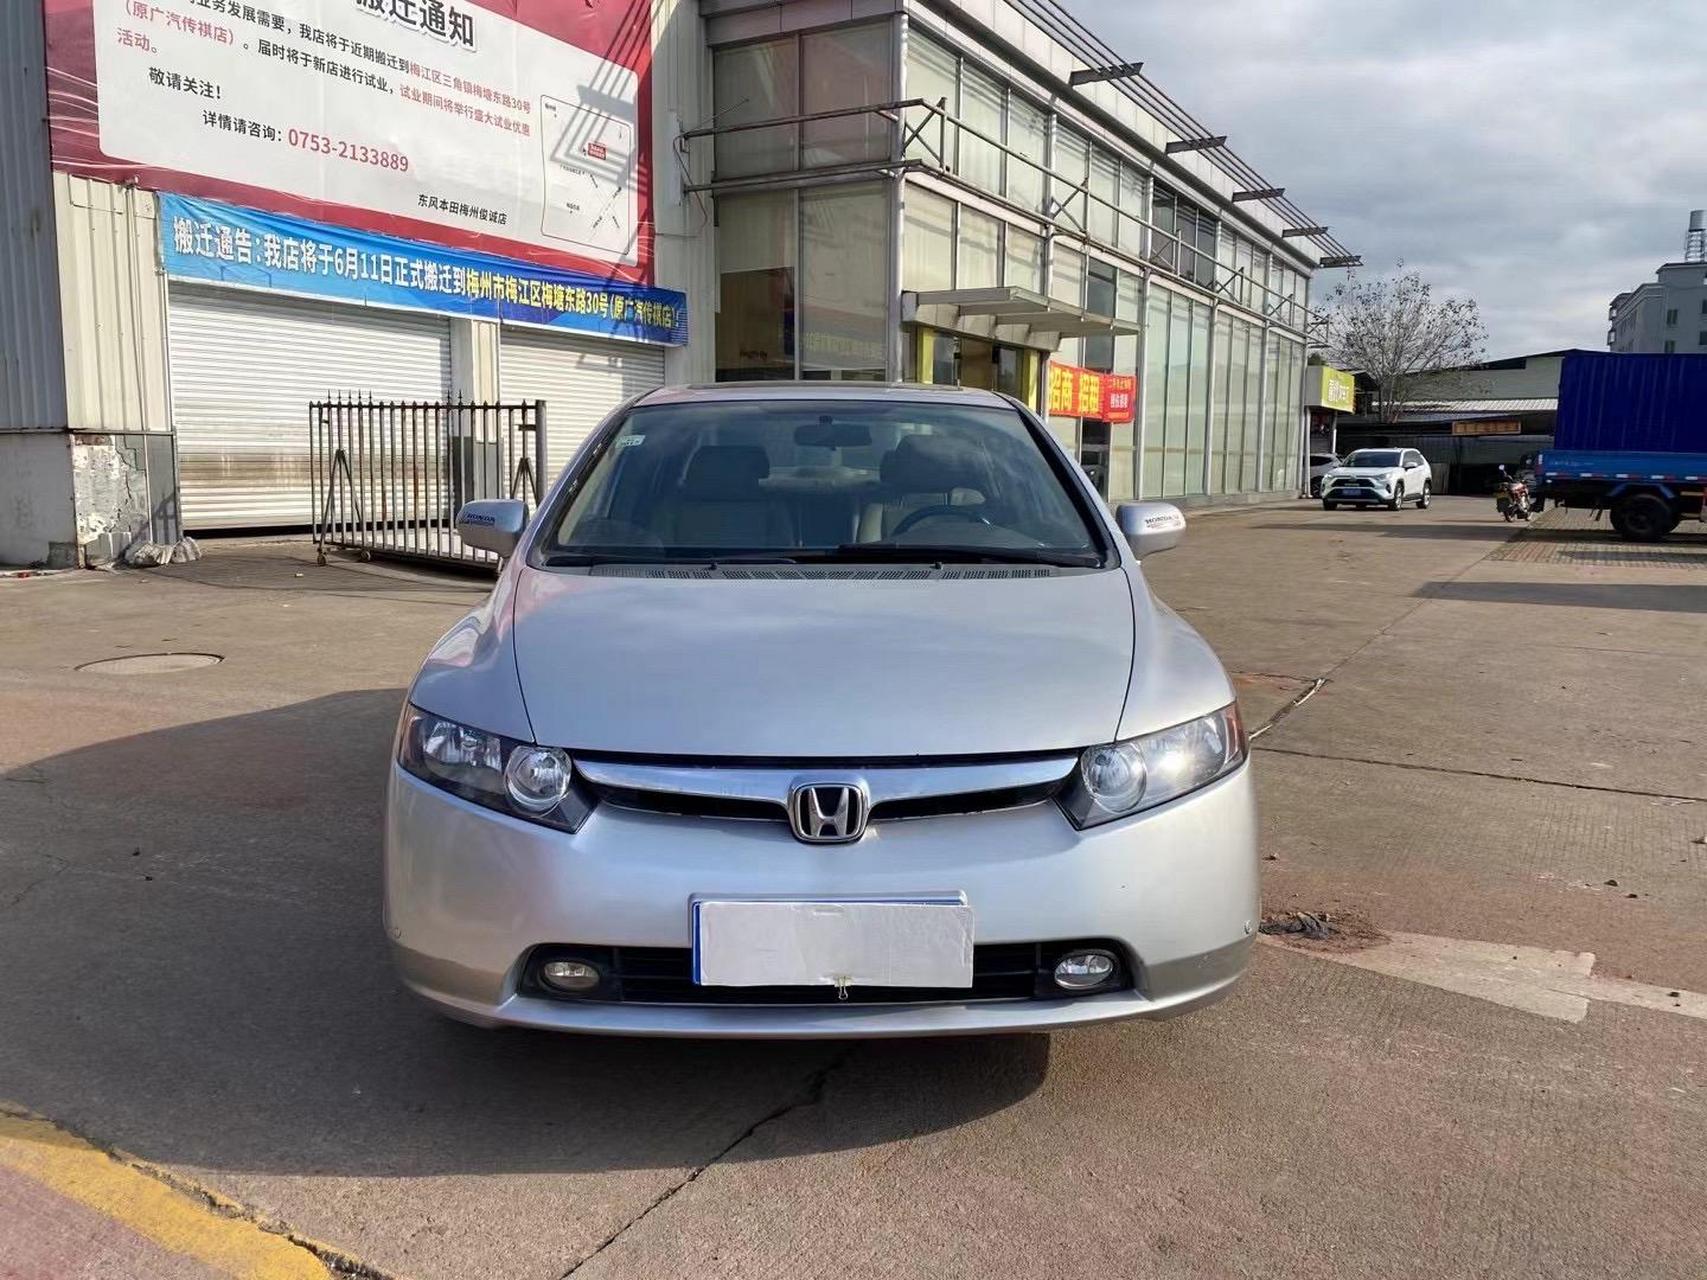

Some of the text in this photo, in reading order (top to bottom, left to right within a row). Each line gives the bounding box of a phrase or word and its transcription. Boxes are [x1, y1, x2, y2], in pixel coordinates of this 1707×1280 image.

[148, 67, 222, 100] 敬请关注！
[1049, 365, 1100, 415] 招商 招租
